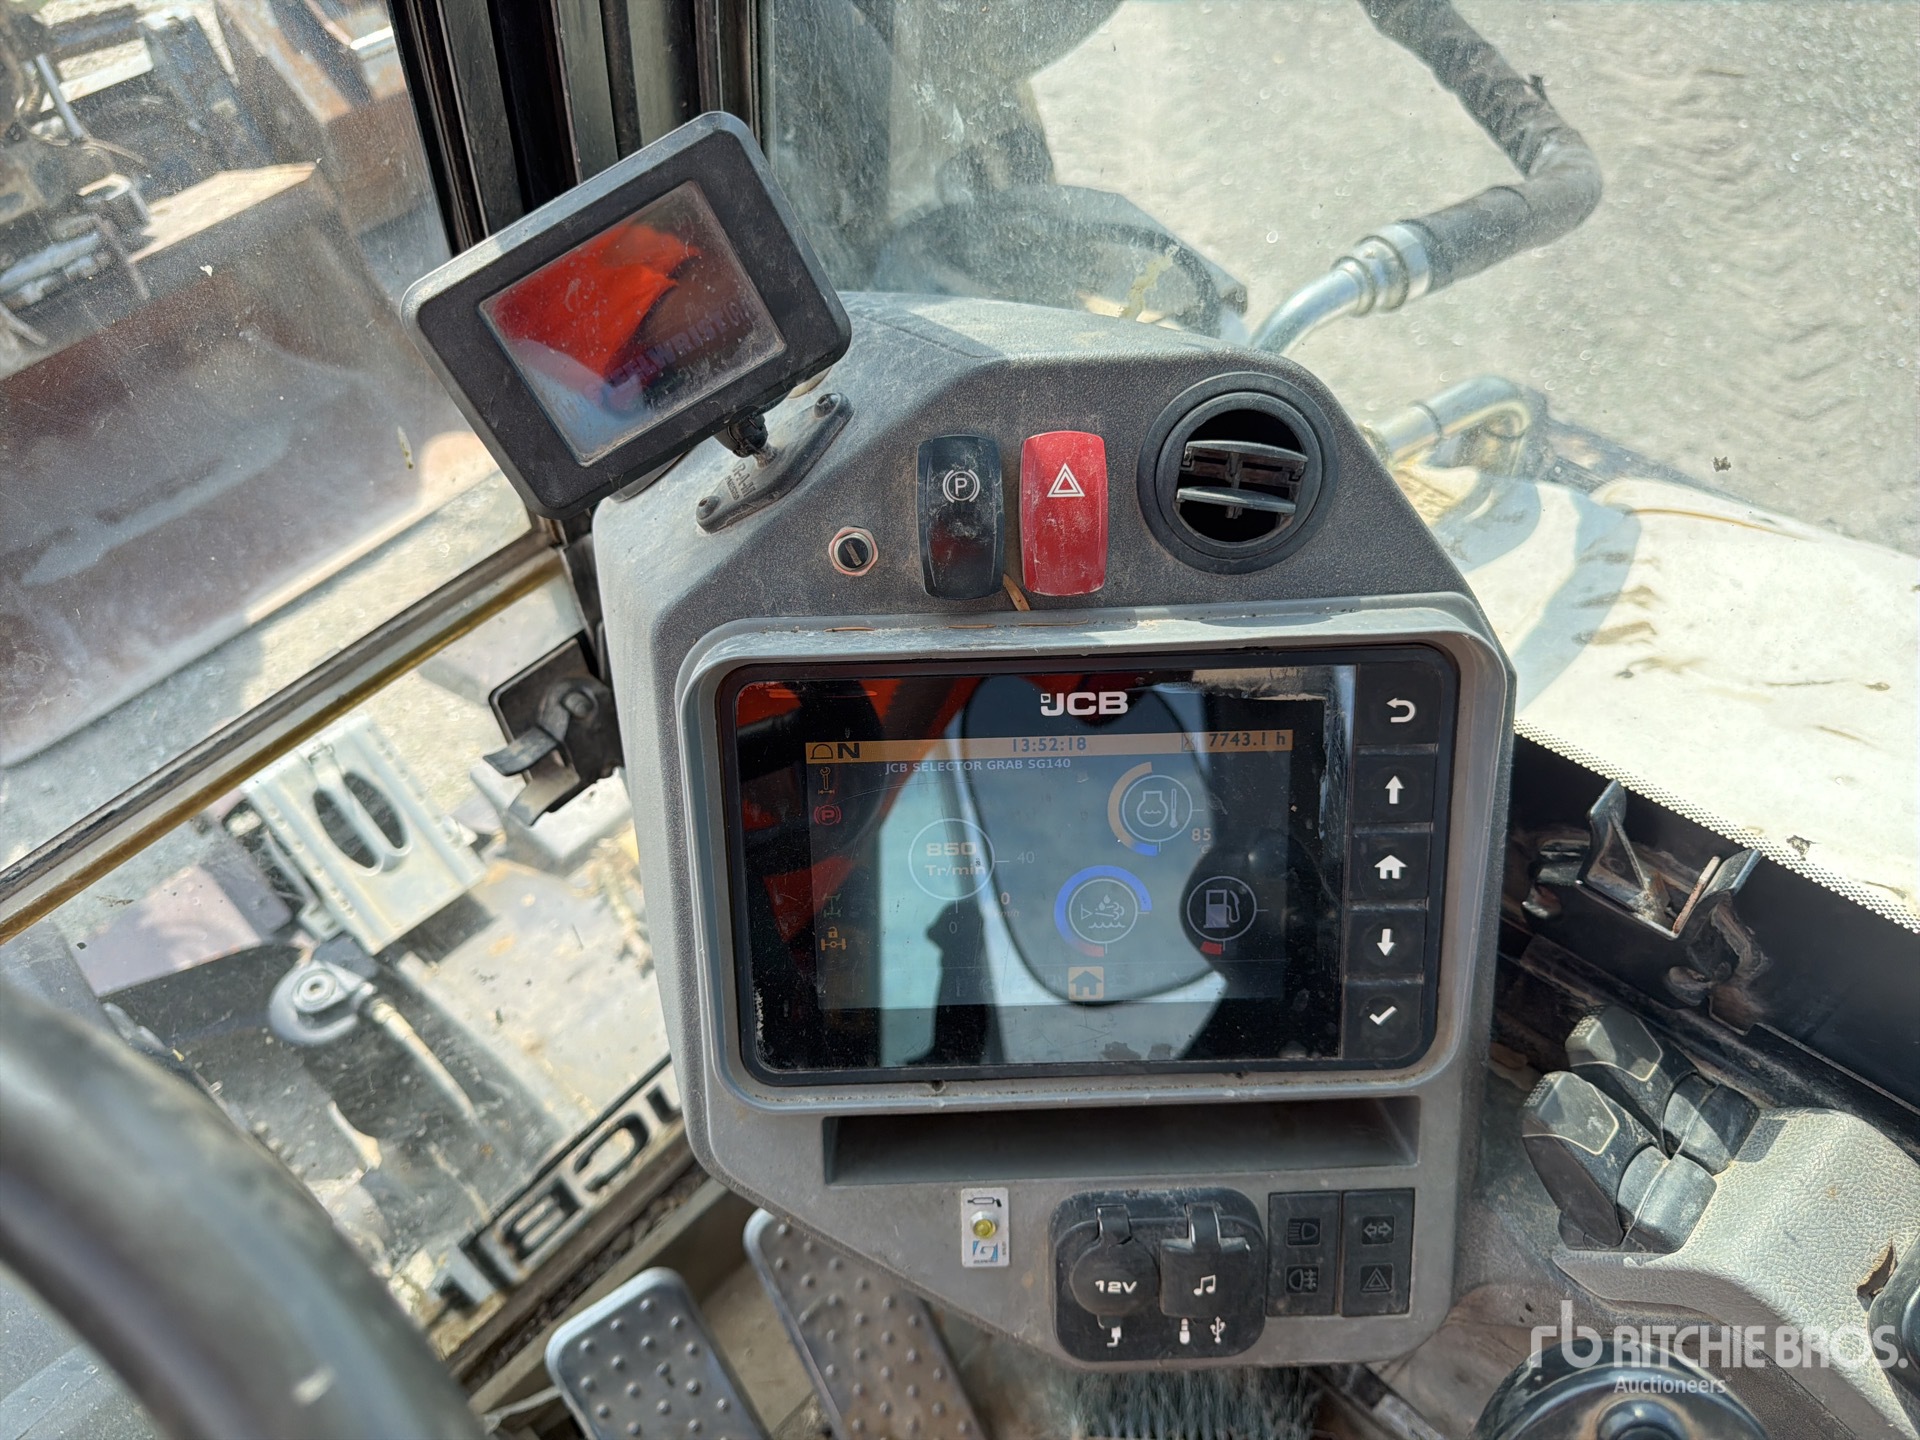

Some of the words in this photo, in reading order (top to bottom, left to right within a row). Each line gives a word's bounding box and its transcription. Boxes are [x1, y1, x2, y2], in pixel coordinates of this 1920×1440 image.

[1040, 691, 1128, 717] JCB
[1012, 736, 1087, 752] 13:52:18
[1209, 732, 1266, 748] 7743.1
[1276, 732, 1286, 745] h
[837, 742, 861, 759] N
[885, 762, 908, 775] JCB
[912, 761, 982, 773] SELECTOR
[986, 759, 1023, 771] GRAB
[1027, 758, 1071, 770] SG140
[1191, 828, 1211, 841] 85
[926, 841, 977, 857] 850
[1016, 850, 1036, 864] 40
[924, 862, 987, 877] Tr/min
[1000, 892, 1011, 905] 0
[949, 921, 958, 934] 0
[1094, 1279, 1137, 1294] 12V
